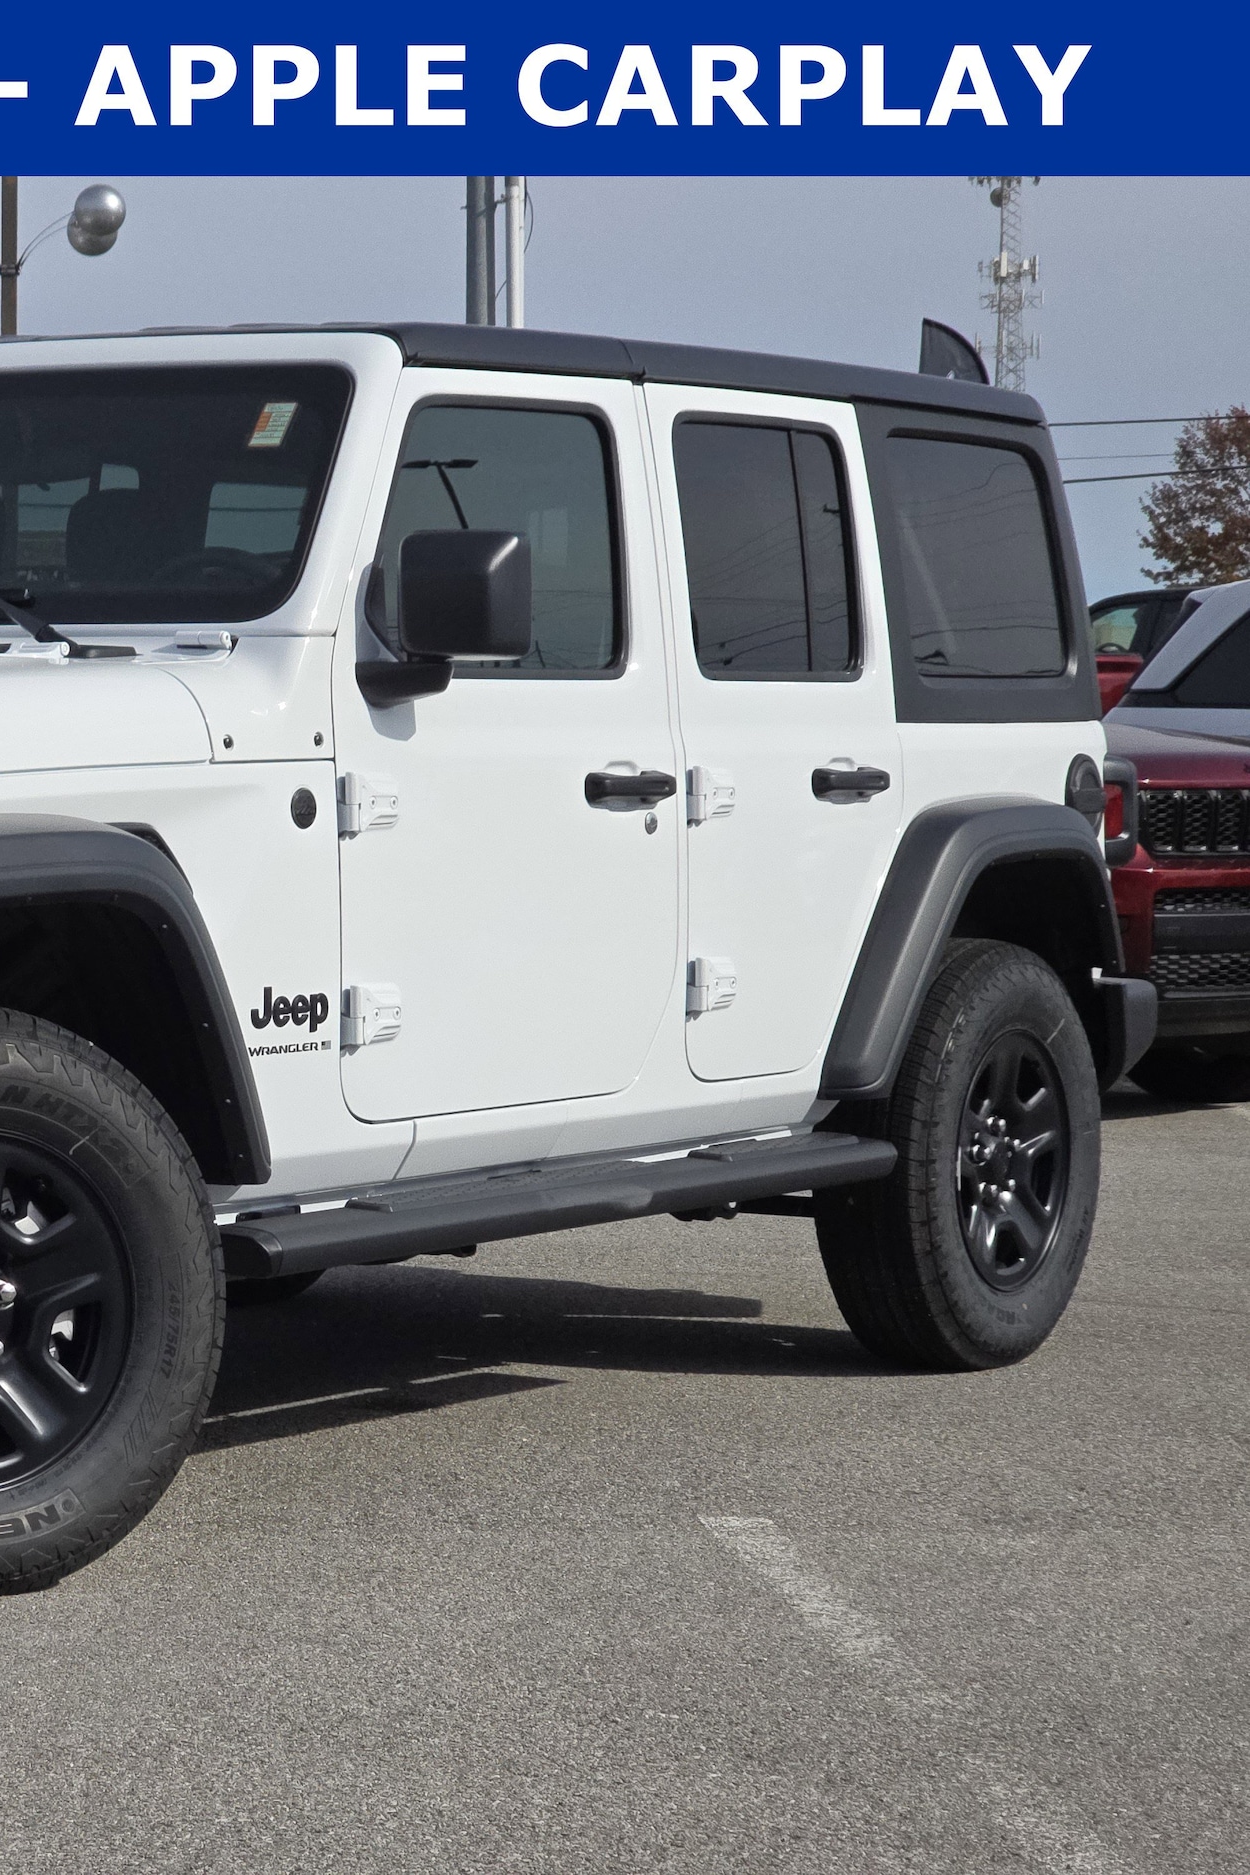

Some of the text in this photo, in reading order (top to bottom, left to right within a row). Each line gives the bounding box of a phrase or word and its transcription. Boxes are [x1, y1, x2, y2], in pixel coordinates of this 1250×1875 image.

[250, 986, 329, 1033] Jeep
[248, 1042, 319, 1057] WRANGLER
[160, 1280, 181, 1379] 245/75R17
